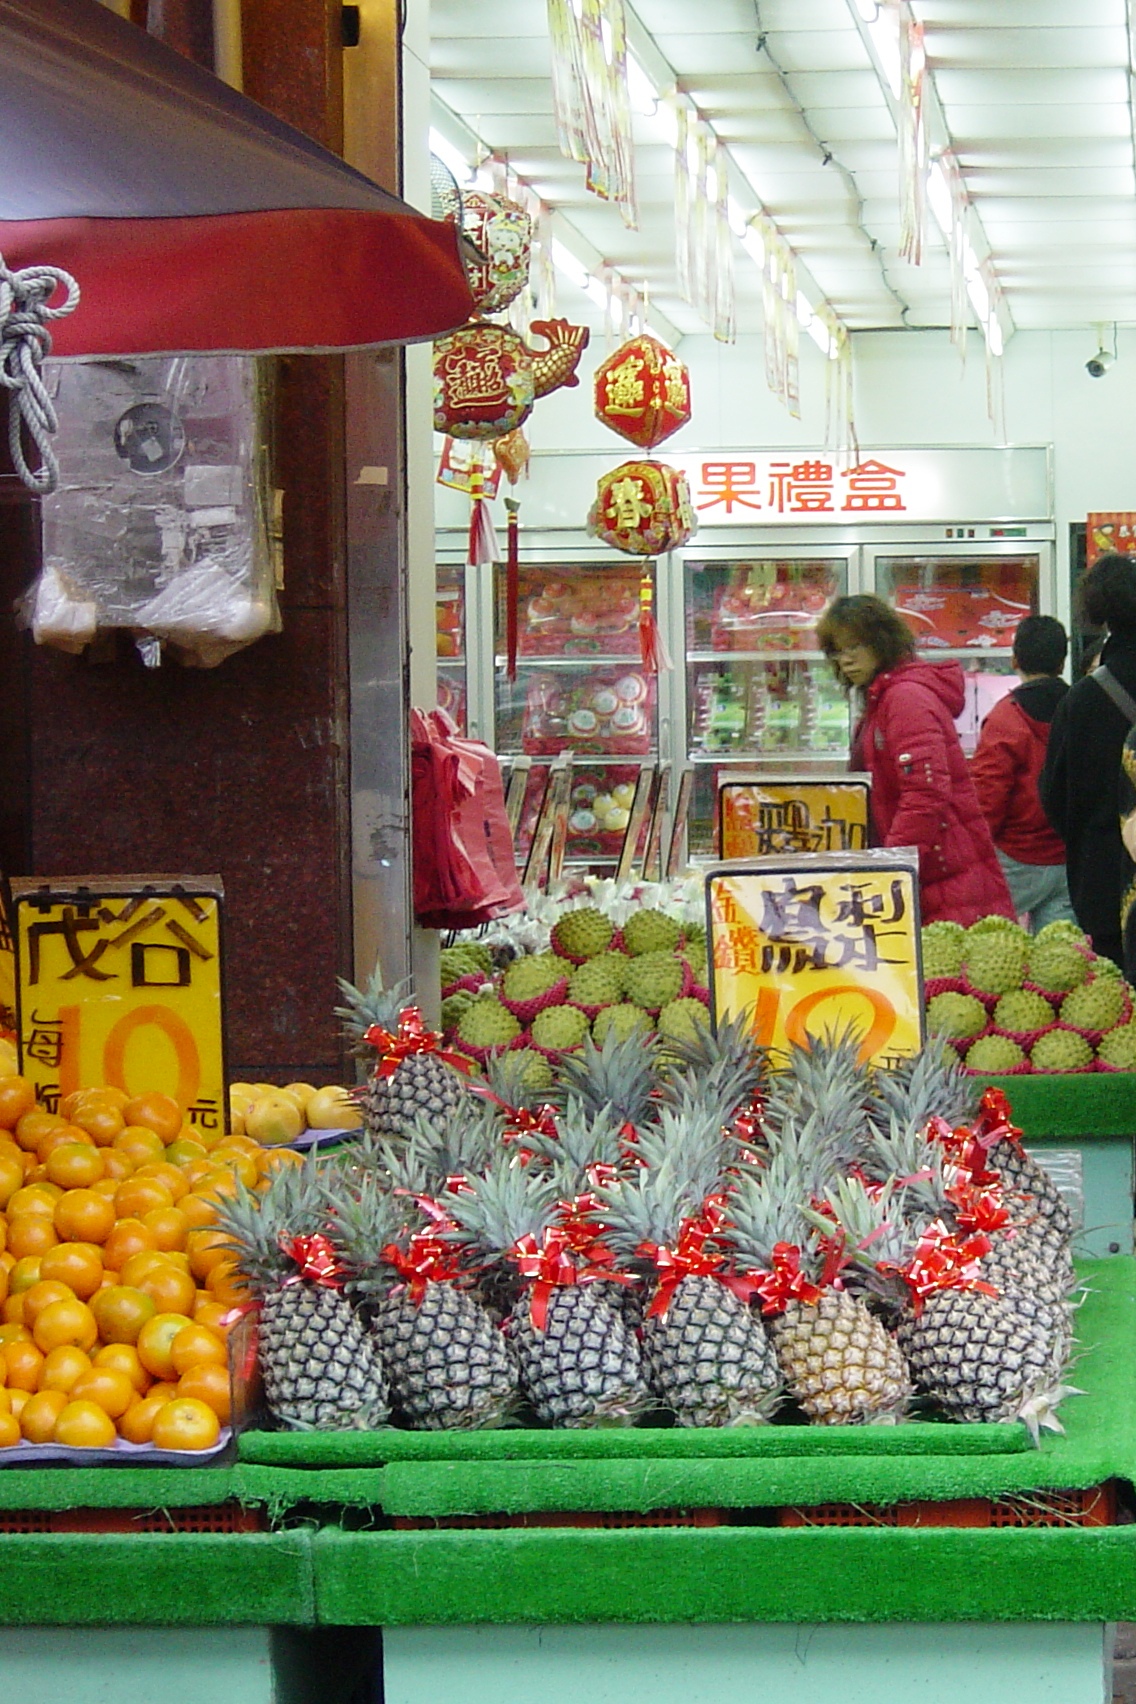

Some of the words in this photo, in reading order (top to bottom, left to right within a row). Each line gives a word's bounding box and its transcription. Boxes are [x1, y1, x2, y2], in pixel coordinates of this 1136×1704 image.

[605, 476, 653, 530] 春
[688, 459, 907, 514] 果禮盒
[27, 884, 214, 987] 茂谷
[57, 1004, 201, 1110] 10
[187, 1099, 219, 1129] 元
